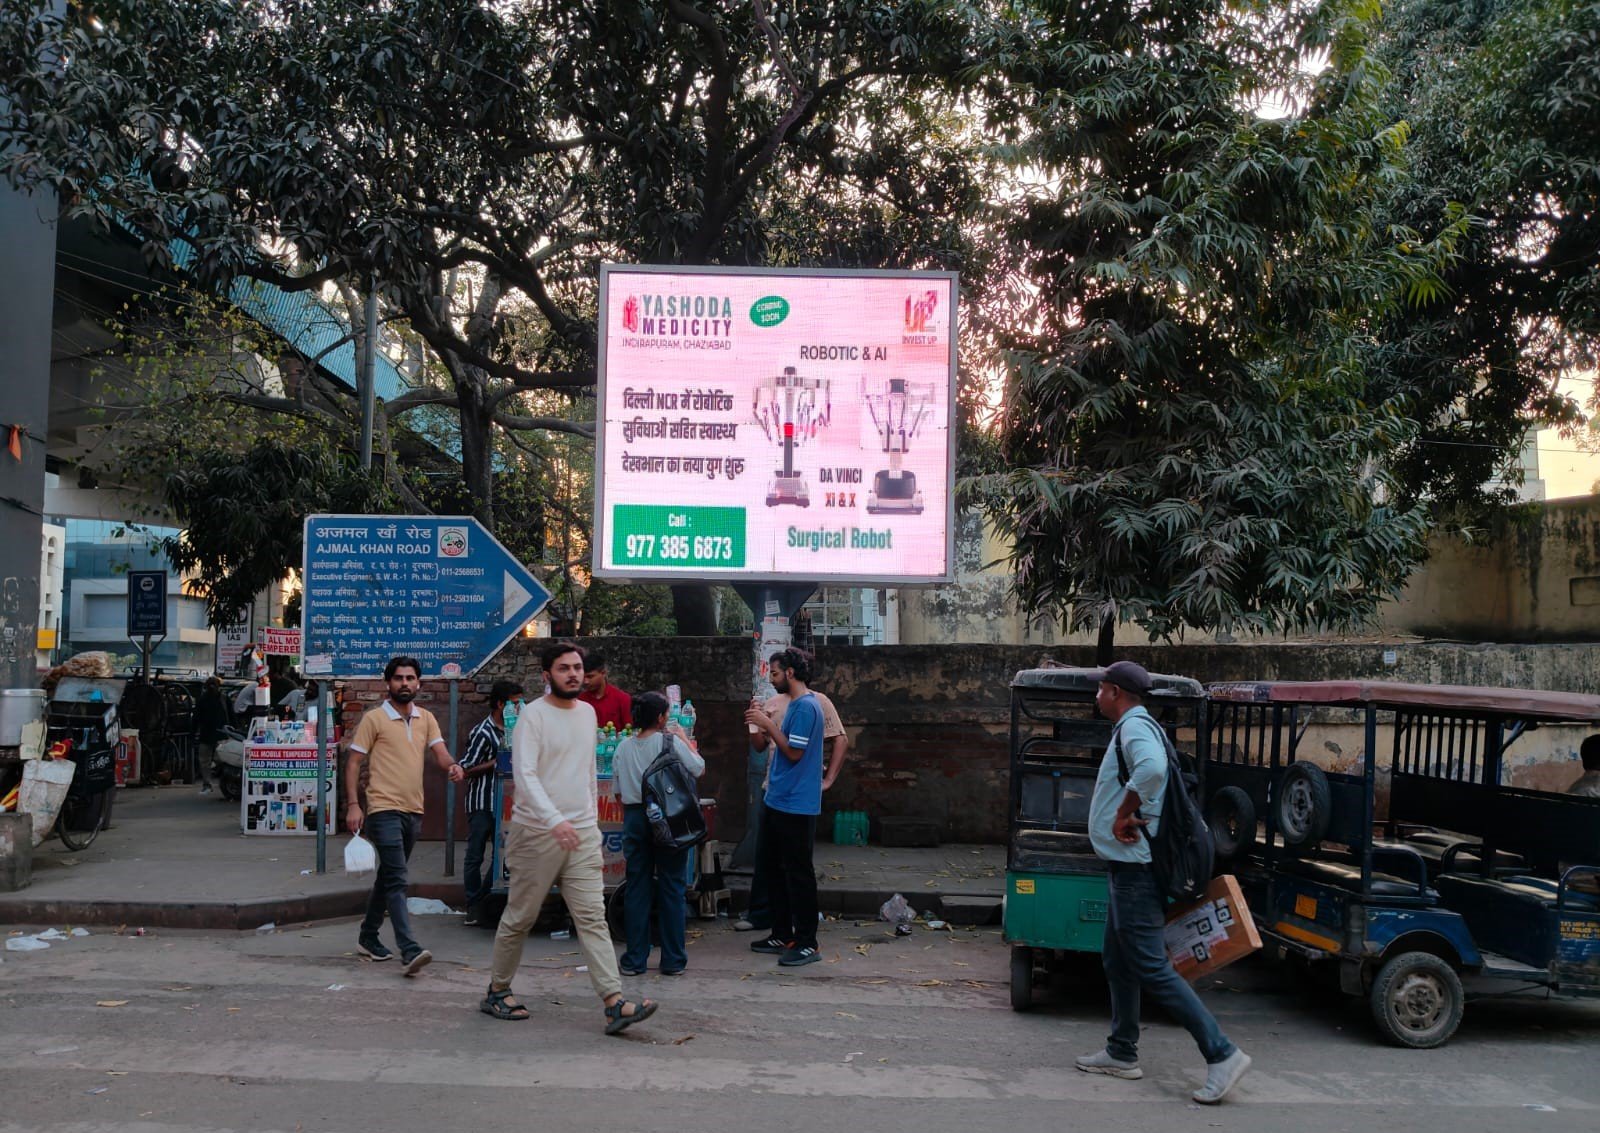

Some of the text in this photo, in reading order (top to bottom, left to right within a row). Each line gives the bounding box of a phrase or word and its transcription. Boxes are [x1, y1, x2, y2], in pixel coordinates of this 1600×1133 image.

[643, 295, 732, 318] YASHODA
[643, 318, 732, 336] MEDICITY
[902, 335, 926, 345] INVEST
[800, 346, 888, 361] ROBOTIC & AI
[622, 387, 734, 411] दिल्ली NCR में रोबोटिक
[669, 418, 698, 439] सहित
[621, 451, 666, 473] देखभाल
[666, 457, 682, 473] का
[682, 457, 705, 474] नया
[705, 458, 723, 480] युग
[819, 468, 863, 483] DA VINCI
[838, 492, 847, 507] &
[849, 493, 857, 507] X
[668, 513, 687, 528] Call
[315, 527, 369, 539] अजमल
[404, 524, 433, 540] रोड
[787, 526, 893, 553] Surgical Robot
[316, 543, 431, 555] AJMAL KHAN ROAD
[627, 534, 733, 560] 977 385 6873
[312, 572, 342, 581] Executive
[312, 600, 340, 608] Assistant
[311, 627, 332, 635] Junior
[268, 636, 284, 644] ALL
[340, 652, 362, 660] Control
[351, 662, 371, 670] Timing
[250, 750, 259, 759] ALL
[260, 750, 281, 759] MOBILE
[282, 750, 312, 759] TEMPERED
[266, 760, 288, 768] PHONE
